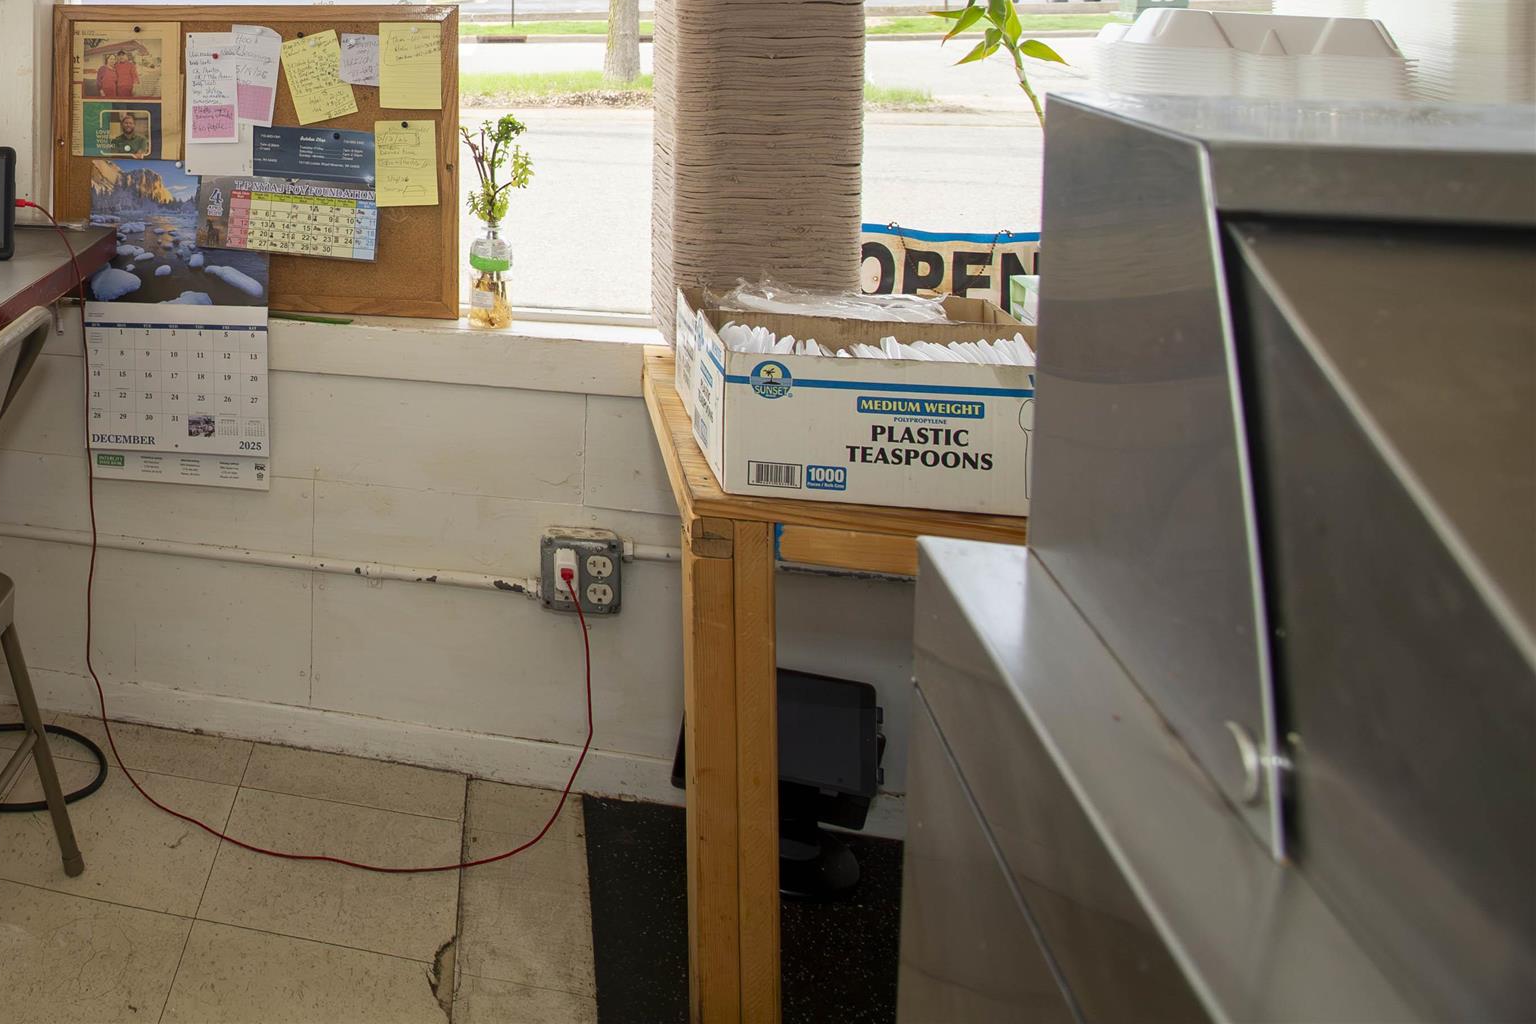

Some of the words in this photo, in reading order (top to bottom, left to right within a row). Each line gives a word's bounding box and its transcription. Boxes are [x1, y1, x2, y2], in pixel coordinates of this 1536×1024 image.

[209, 188, 224, 204] 4
[288, 184, 305, 195] POV
[305, 187, 375, 200] FOUNDATION
[755, 386, 788, 395] SUNSET
[860, 400, 920, 413] MEDIUM
[924, 403, 981, 415] WEIGHT
[893, 416, 947, 425] POLYPROPYLENE
[92, 434, 155, 445] DECEMBER
[240, 441, 262, 450] 2025
[871, 425, 969, 447] PLASTIC
[846, 445, 993, 471] TEASPOONS
[809, 468, 844, 482] 1000
